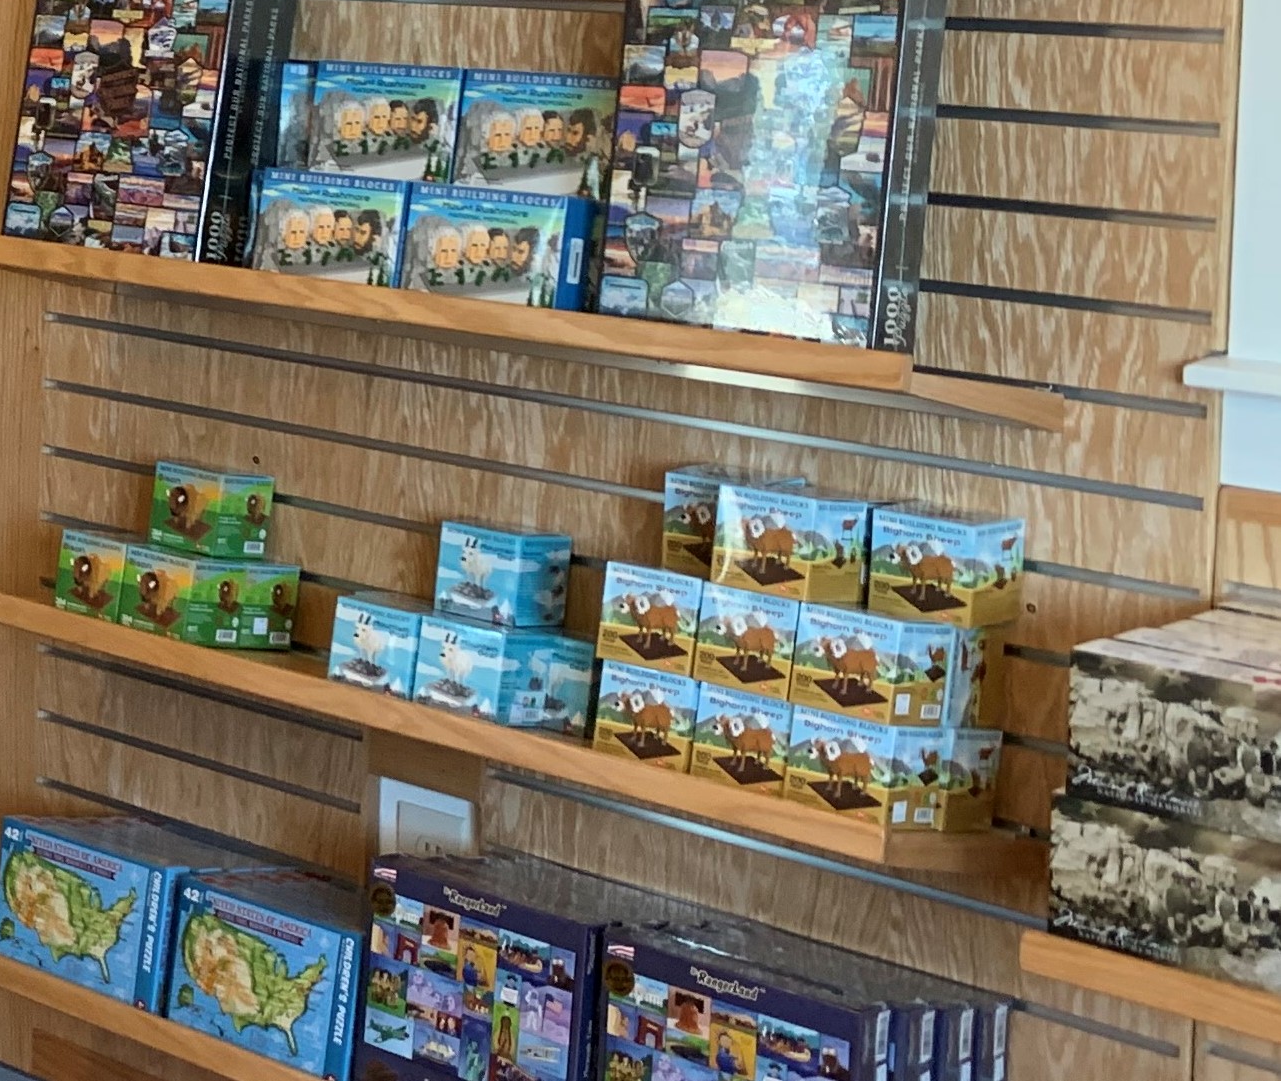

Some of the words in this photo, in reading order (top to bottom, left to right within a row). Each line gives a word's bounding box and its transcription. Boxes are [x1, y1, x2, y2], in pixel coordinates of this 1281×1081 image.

[326, 63, 351, 72] MINI
[355, 64, 406, 76] BUILDING
[411, 66, 452, 78] BLOCKS
[473, 72, 501, 82] MINI
[505, 74, 562, 85] BUILDING
[566, 77, 611, 88] BLOCKS
[270, 171, 296, 180] MINI
[300, 173, 351, 187] BUILDING
[354, 178, 395, 192] BLOCKS
[420, 185, 447, 195] MINI
[451, 188, 508, 202] BUILDING
[511, 193, 558, 207] BLOCKS
[205, 210, 224, 261] 1000
[883, 286, 901, 348] 1000
[882, 525, 923, 540] Bighorn
[926, 533, 961, 547] Sheep
[615, 577, 653, 590] Bighorn
[656, 584, 688, 597] Sheep
[4, 827, 20, 841] 42
[147, 871, 163, 933] CHILDREN'S
[183, 887, 200, 902] 42
[448, 889, 502, 917] RangerLand
[142, 935, 155, 973] PUZZLE
[338, 937, 355, 1003] CHILDREN'S
[697, 970, 759, 1001] RangerLand
[332, 1004, 347, 1046] PUZZLE
